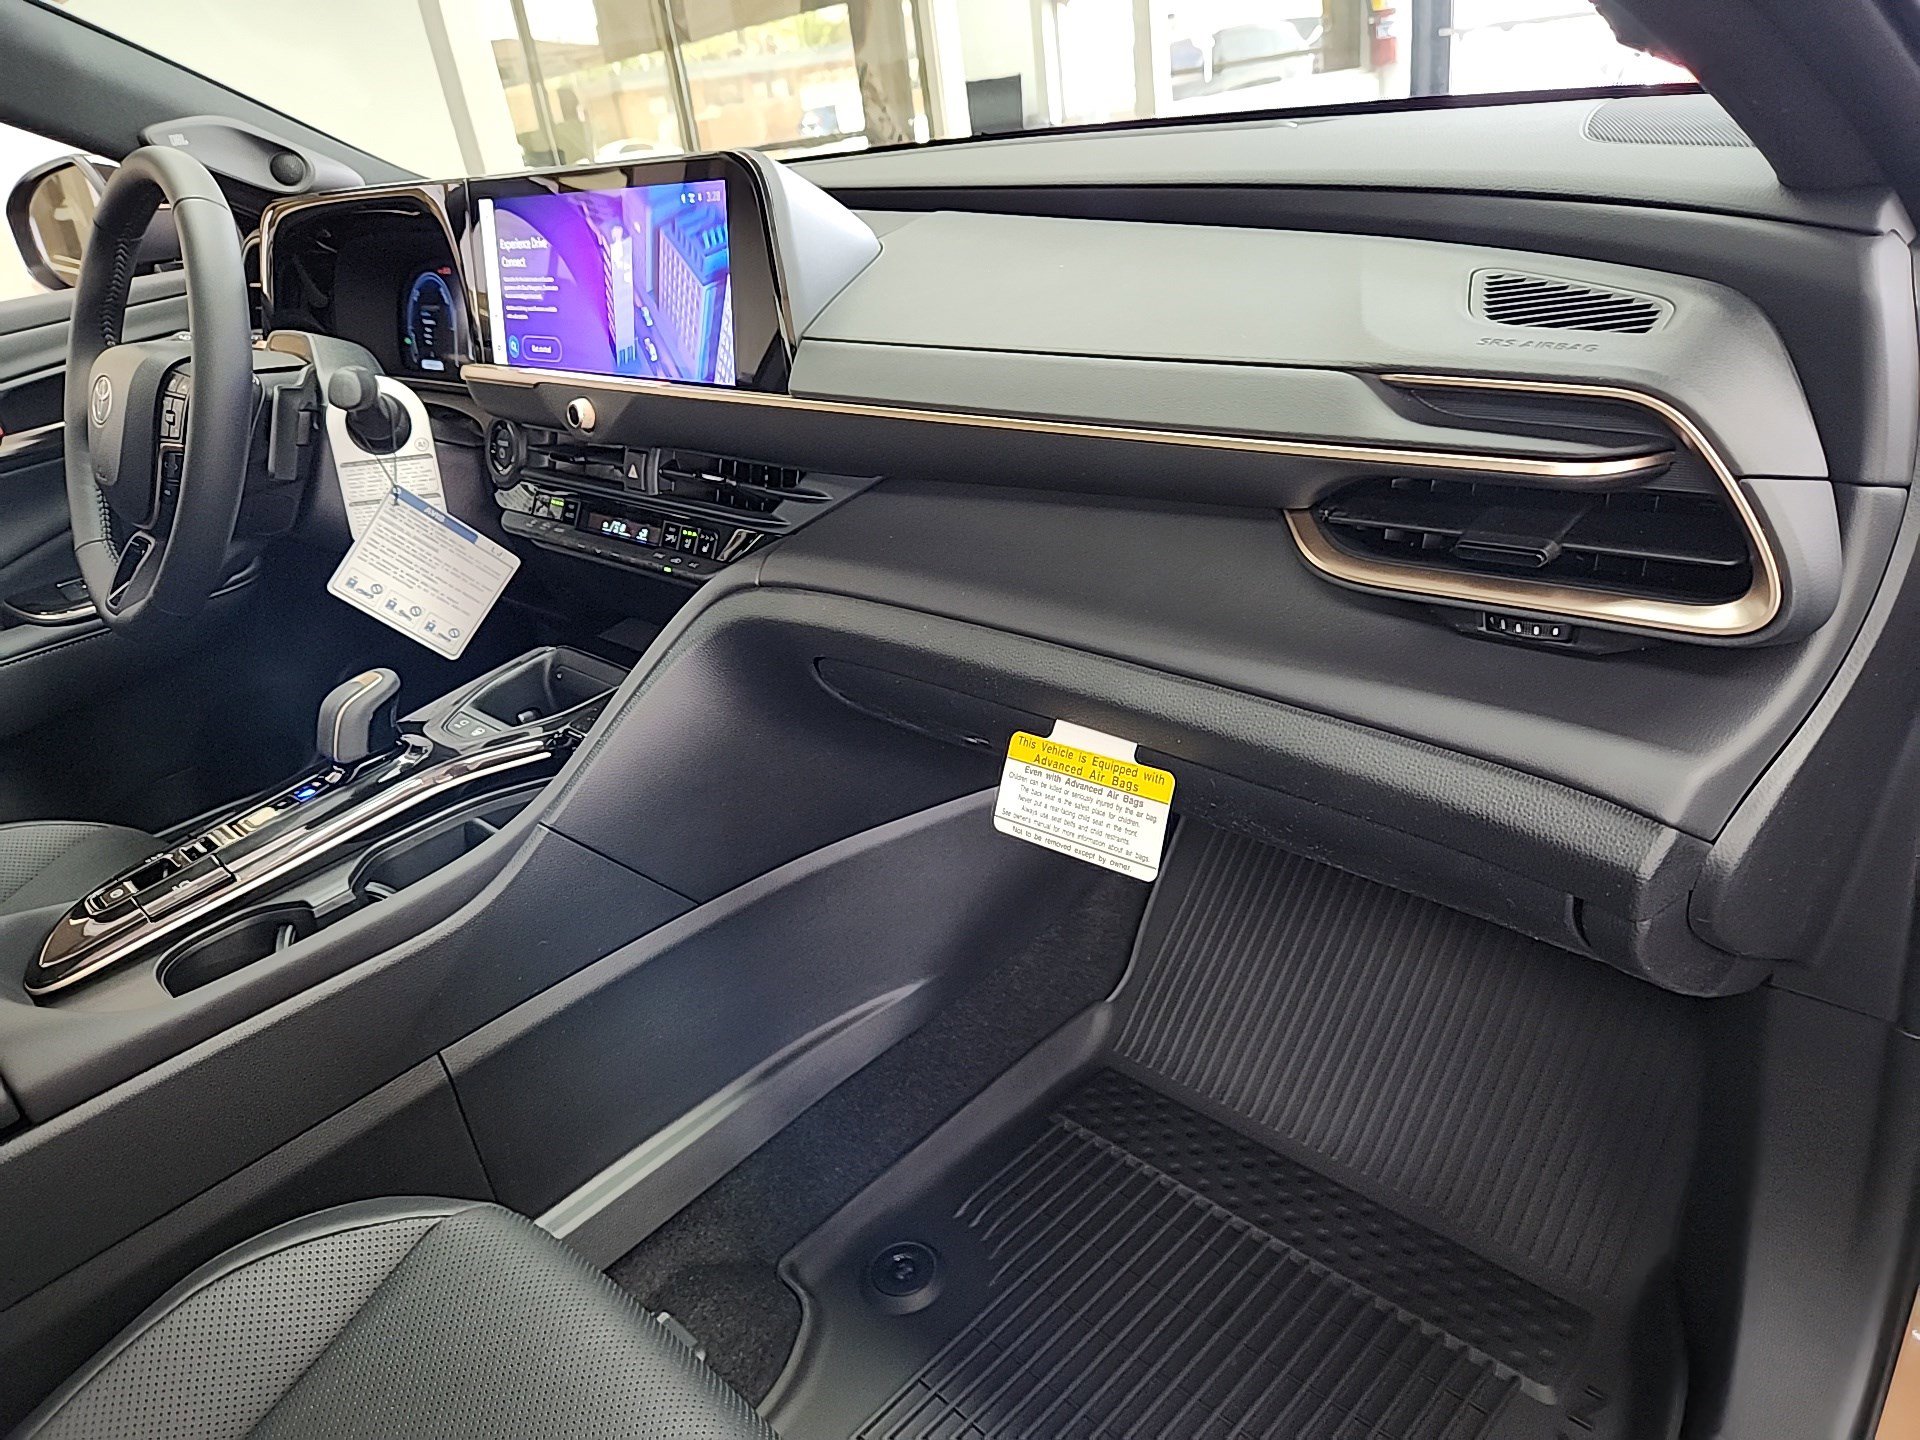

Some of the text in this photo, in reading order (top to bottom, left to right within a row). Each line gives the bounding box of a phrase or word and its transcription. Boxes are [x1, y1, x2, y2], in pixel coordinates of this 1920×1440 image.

[1476, 337, 1599, 353] SRS AIRBAG
[1018, 735, 1165, 786] This Vehicle is Equipped with
[1033, 754, 1139, 792] Advanced Air Bags
[1024, 765, 1144, 809] Even with Advanced Air Bags
[1001, 807, 1012, 817] See
[1115, 804, 1123, 814] by
[1012, 825, 1023, 836] Not
[1025, 830, 1032, 838] to
[1033, 833, 1042, 842] be
[1044, 837, 1072, 852] removed
[1074, 847, 1096, 860] except
[1098, 854, 1107, 865] by
